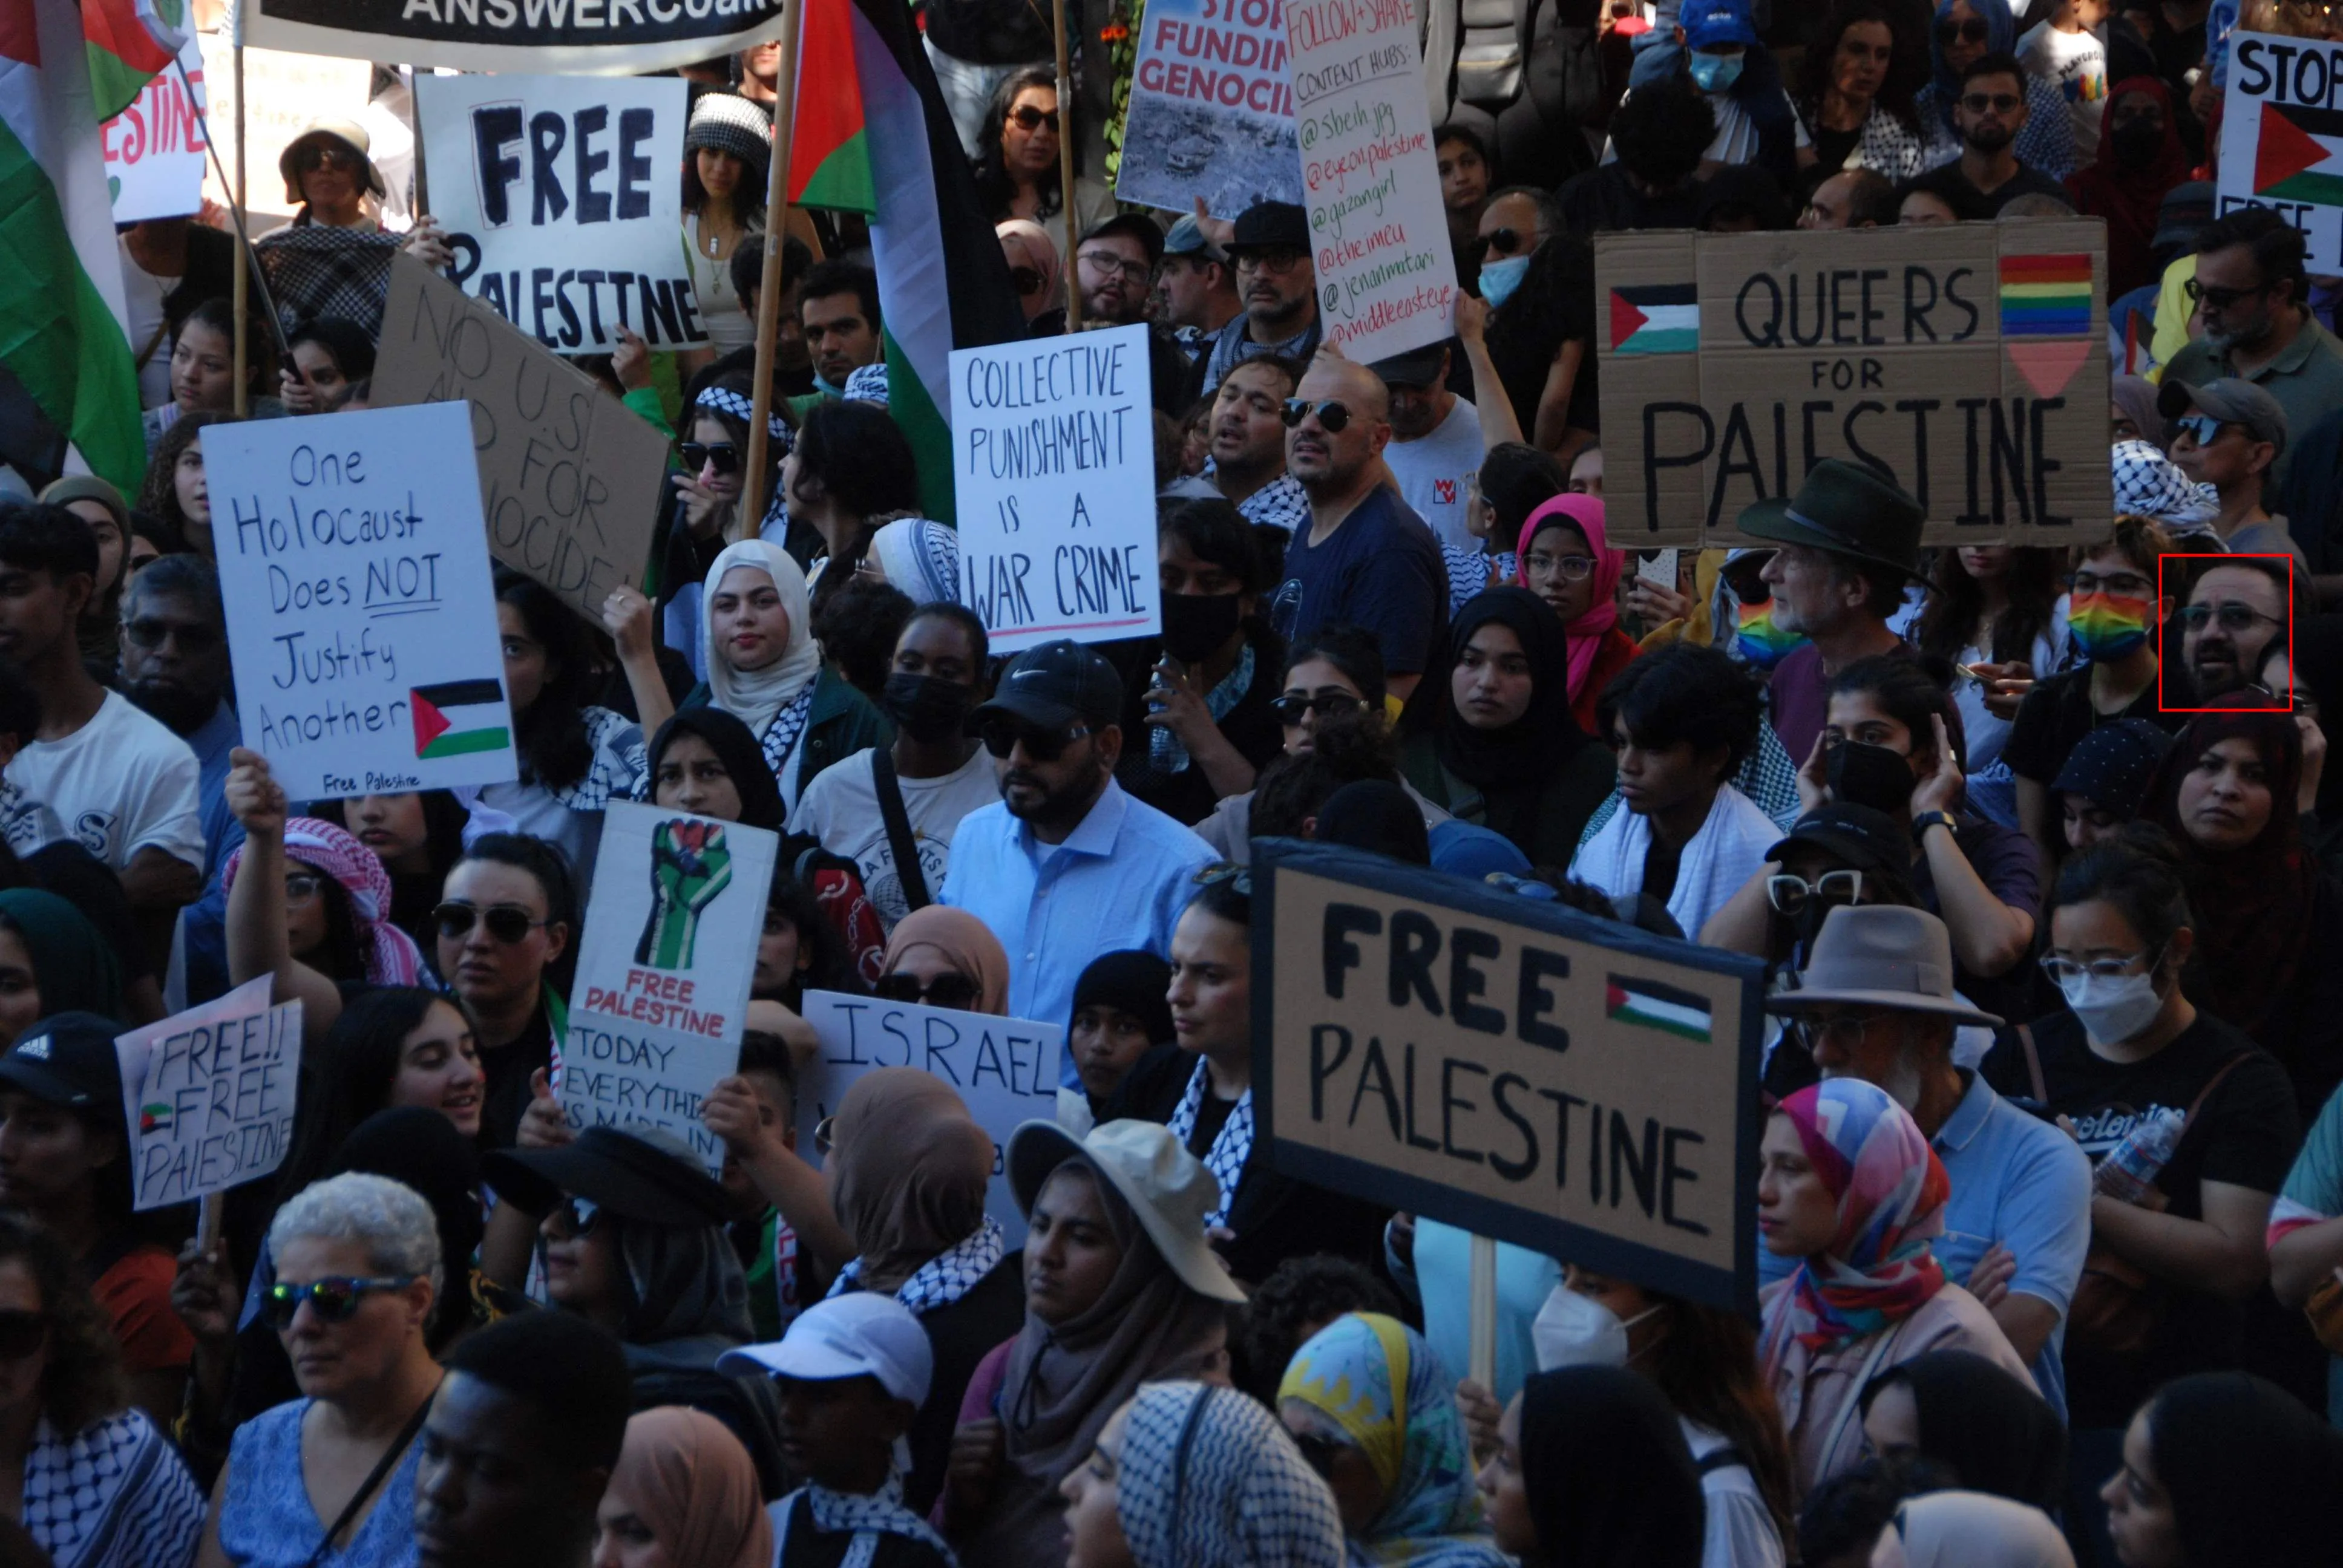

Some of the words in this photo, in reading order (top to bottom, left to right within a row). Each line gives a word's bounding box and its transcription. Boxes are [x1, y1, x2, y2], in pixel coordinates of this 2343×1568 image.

[1296, 56, 1364, 101] CONTENT
[1370, 44, 1411, 74] HUBS:
[470, 100, 654, 229] FREE
[1311, 169, 1397, 240] @gazangirl
[413, 284, 491, 379] NO
[1735, 266, 1978, 348] QUEERS
[968, 343, 1127, 408] COLLECTIVE
[1812, 359, 1883, 390] FOR
[290, 445, 365, 486] One
[970, 406, 1133, 479] PUNISHMENT
[232, 491, 423, 556] Holocaust
[520, 437, 609, 545] FOR
[998, 495, 1020, 534] IS
[1072, 492, 1091, 528] A
[269, 564, 350, 613] Does
[364, 553, 442, 604] NOT
[968, 553, 1035, 630] WAR
[1055, 544, 1146, 616] CRIME
[272, 627, 396, 689] Justify
[260, 699, 407, 754] Another
[323, 774, 356, 792] Free
[366, 771, 421, 789] Palestine
[583, 986, 725, 1038] PALESTINE
[626, 968, 696, 1005] FREE
[1322, 902, 1571, 1054] FREE
[157, 1007, 286, 1089] FREE!!
[827, 1004, 1057, 1098] ISRAEL
[173, 1061, 284, 1142] FREE
[1309, 1022, 1710, 1237] PALESTINE
